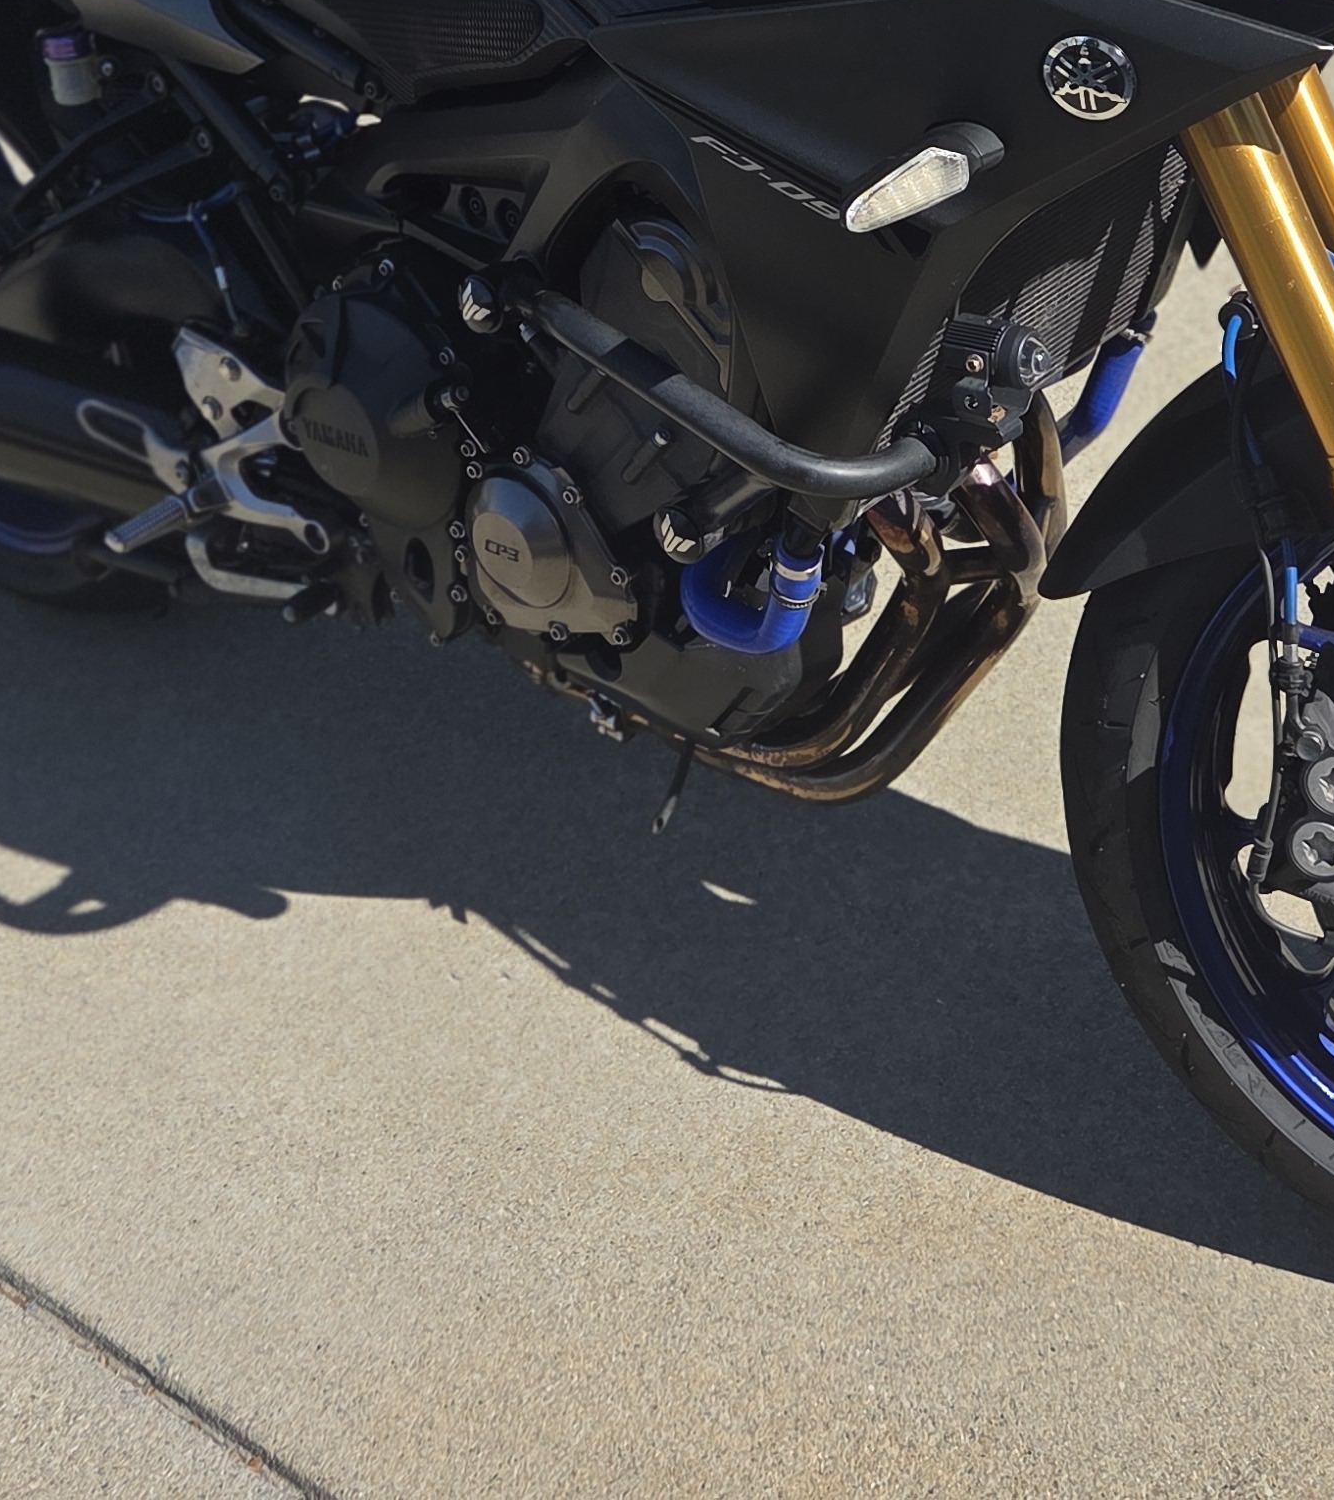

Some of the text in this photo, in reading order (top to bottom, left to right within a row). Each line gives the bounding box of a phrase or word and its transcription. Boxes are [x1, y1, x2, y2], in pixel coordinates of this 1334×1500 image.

[690, 135, 841, 220] FJ-09
[302, 416, 370, 458] YAMAHA
[484, 538, 520, 563] CP3
